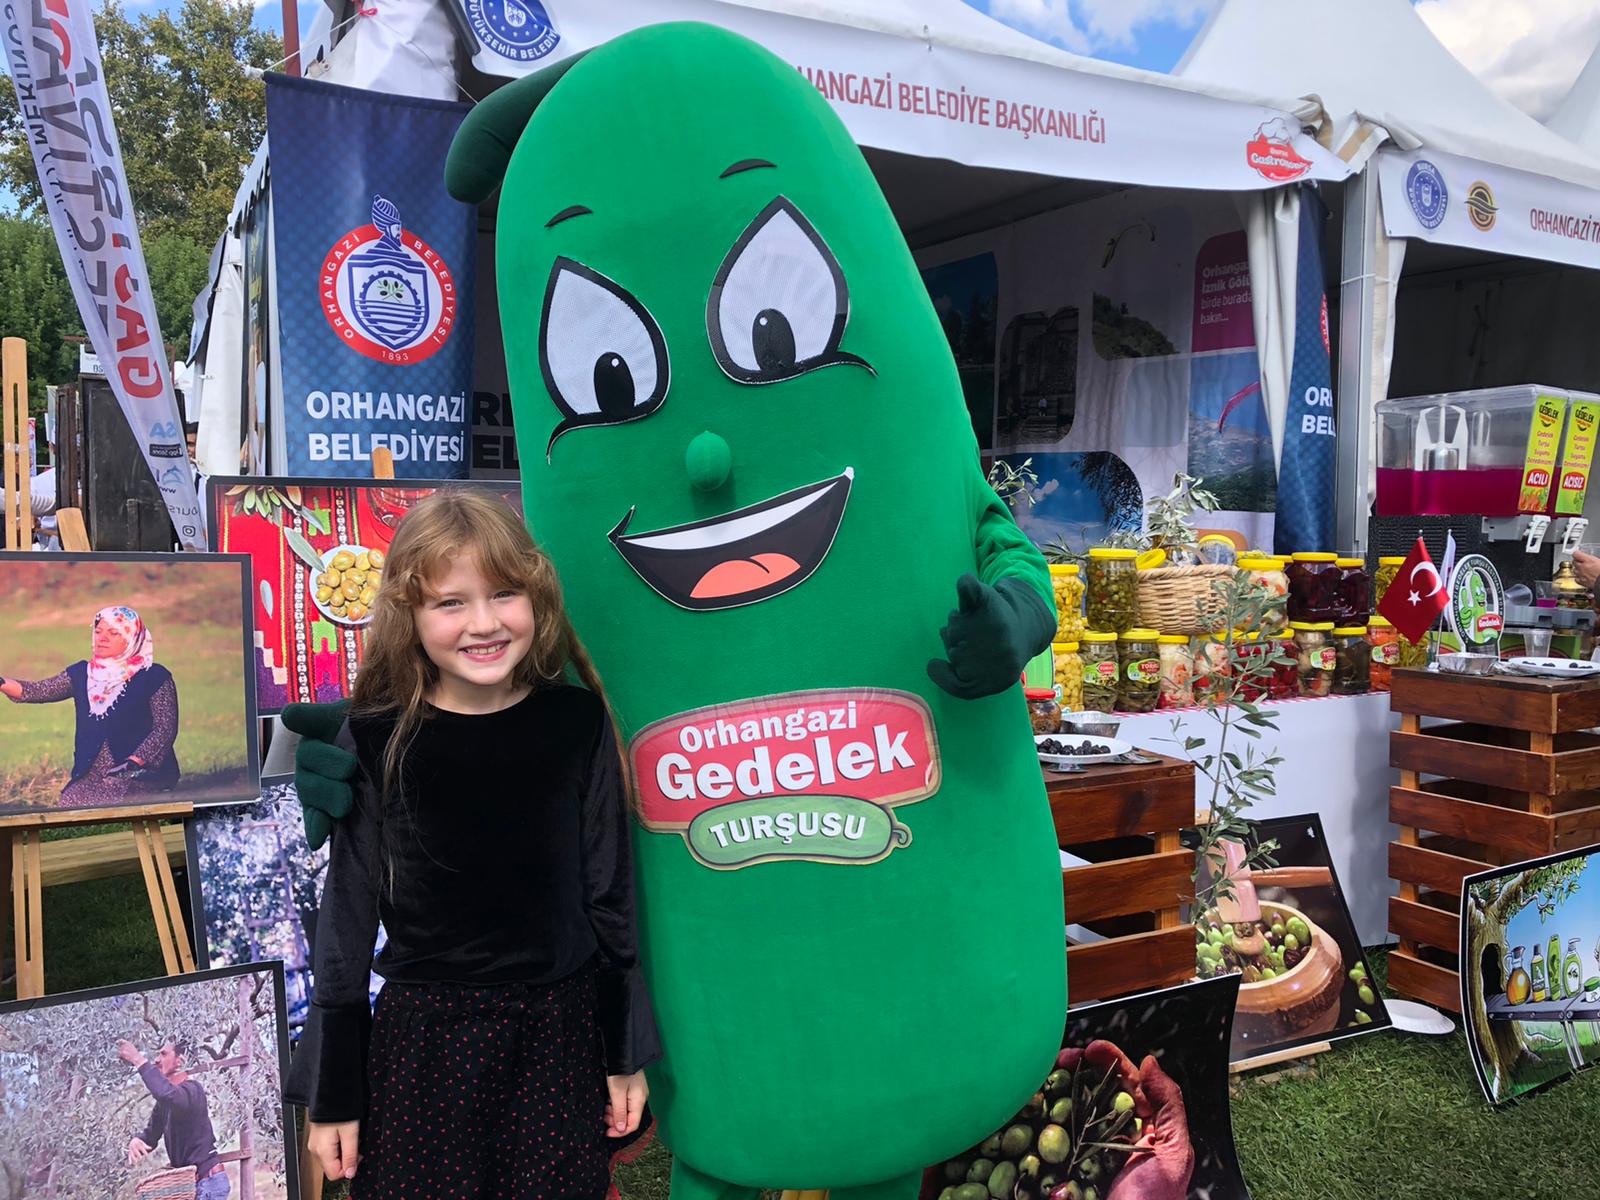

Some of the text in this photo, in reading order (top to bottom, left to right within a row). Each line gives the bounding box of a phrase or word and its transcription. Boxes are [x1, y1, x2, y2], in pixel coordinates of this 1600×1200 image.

[898, 81, 990, 126] BELEDİYE
[995, 99, 1106, 144] BAŞKANLIĞI
[1530, 208, 1592, 241] ORHANGAZİ
[381, 350, 409, 361] 1893
[306, 390, 465, 423] ORHANGAZİ
[308, 428, 465, 462] BELEDİYESİ
[1528, 473, 1548, 485] ACILI
[1563, 476, 1584, 488] ACISIZ
[679, 701, 858, 753] Orhangazi
[655, 723, 916, 801] Gedelek
[708, 811, 867, 849] TURŞUSU
